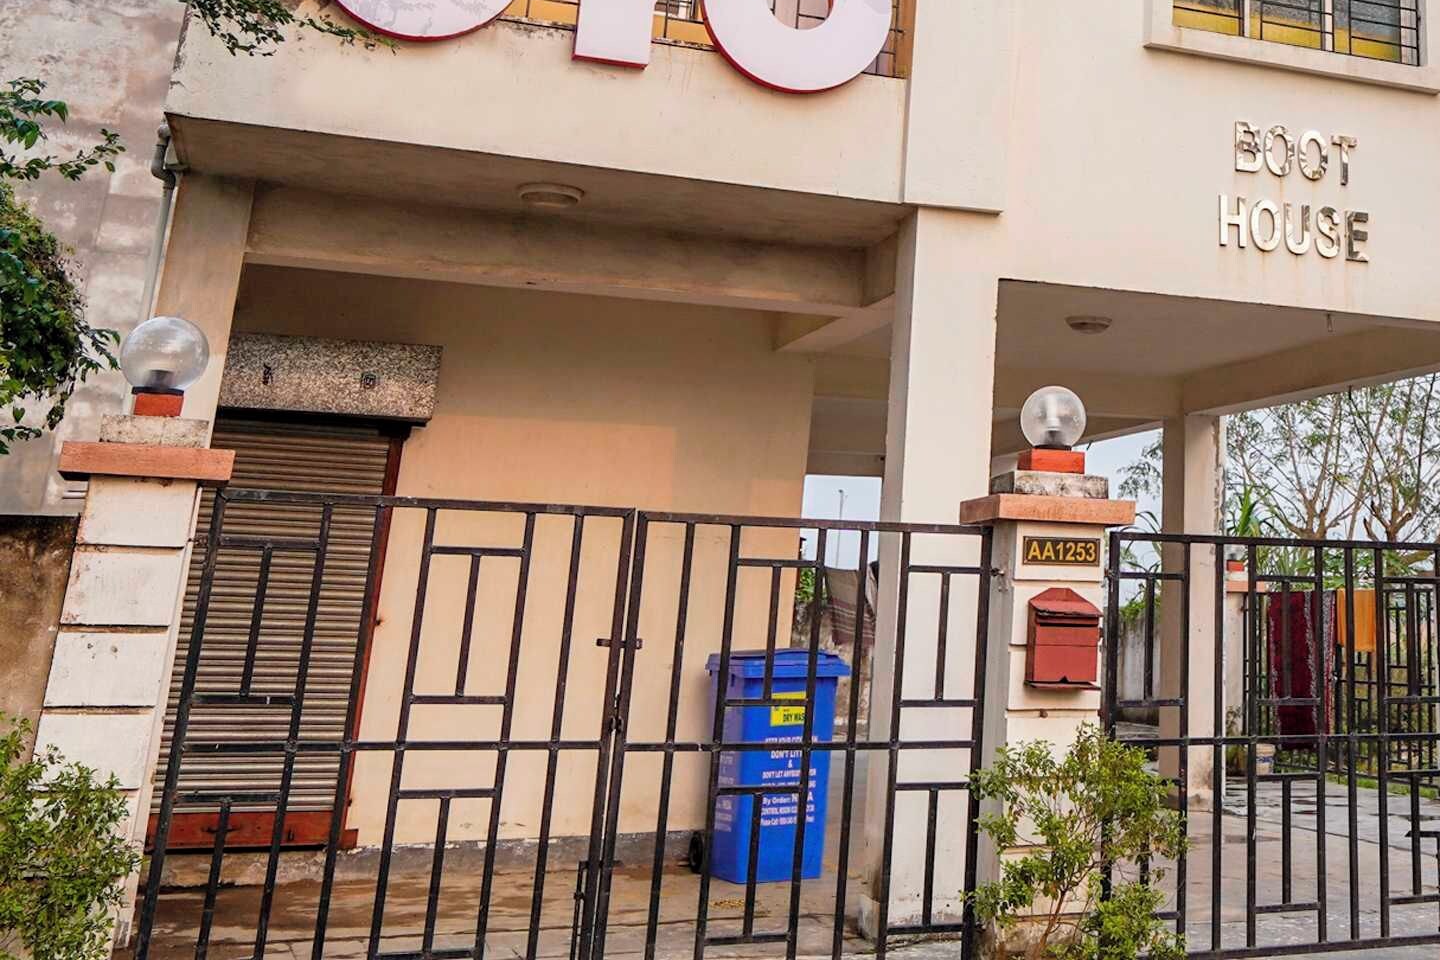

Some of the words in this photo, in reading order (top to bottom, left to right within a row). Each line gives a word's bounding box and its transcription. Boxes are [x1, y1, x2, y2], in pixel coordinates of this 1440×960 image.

[1235, 121, 1358, 186] BOOT
[1218, 194, 1369, 263] HOUSE
[1027, 541, 1096, 562] AA1253
